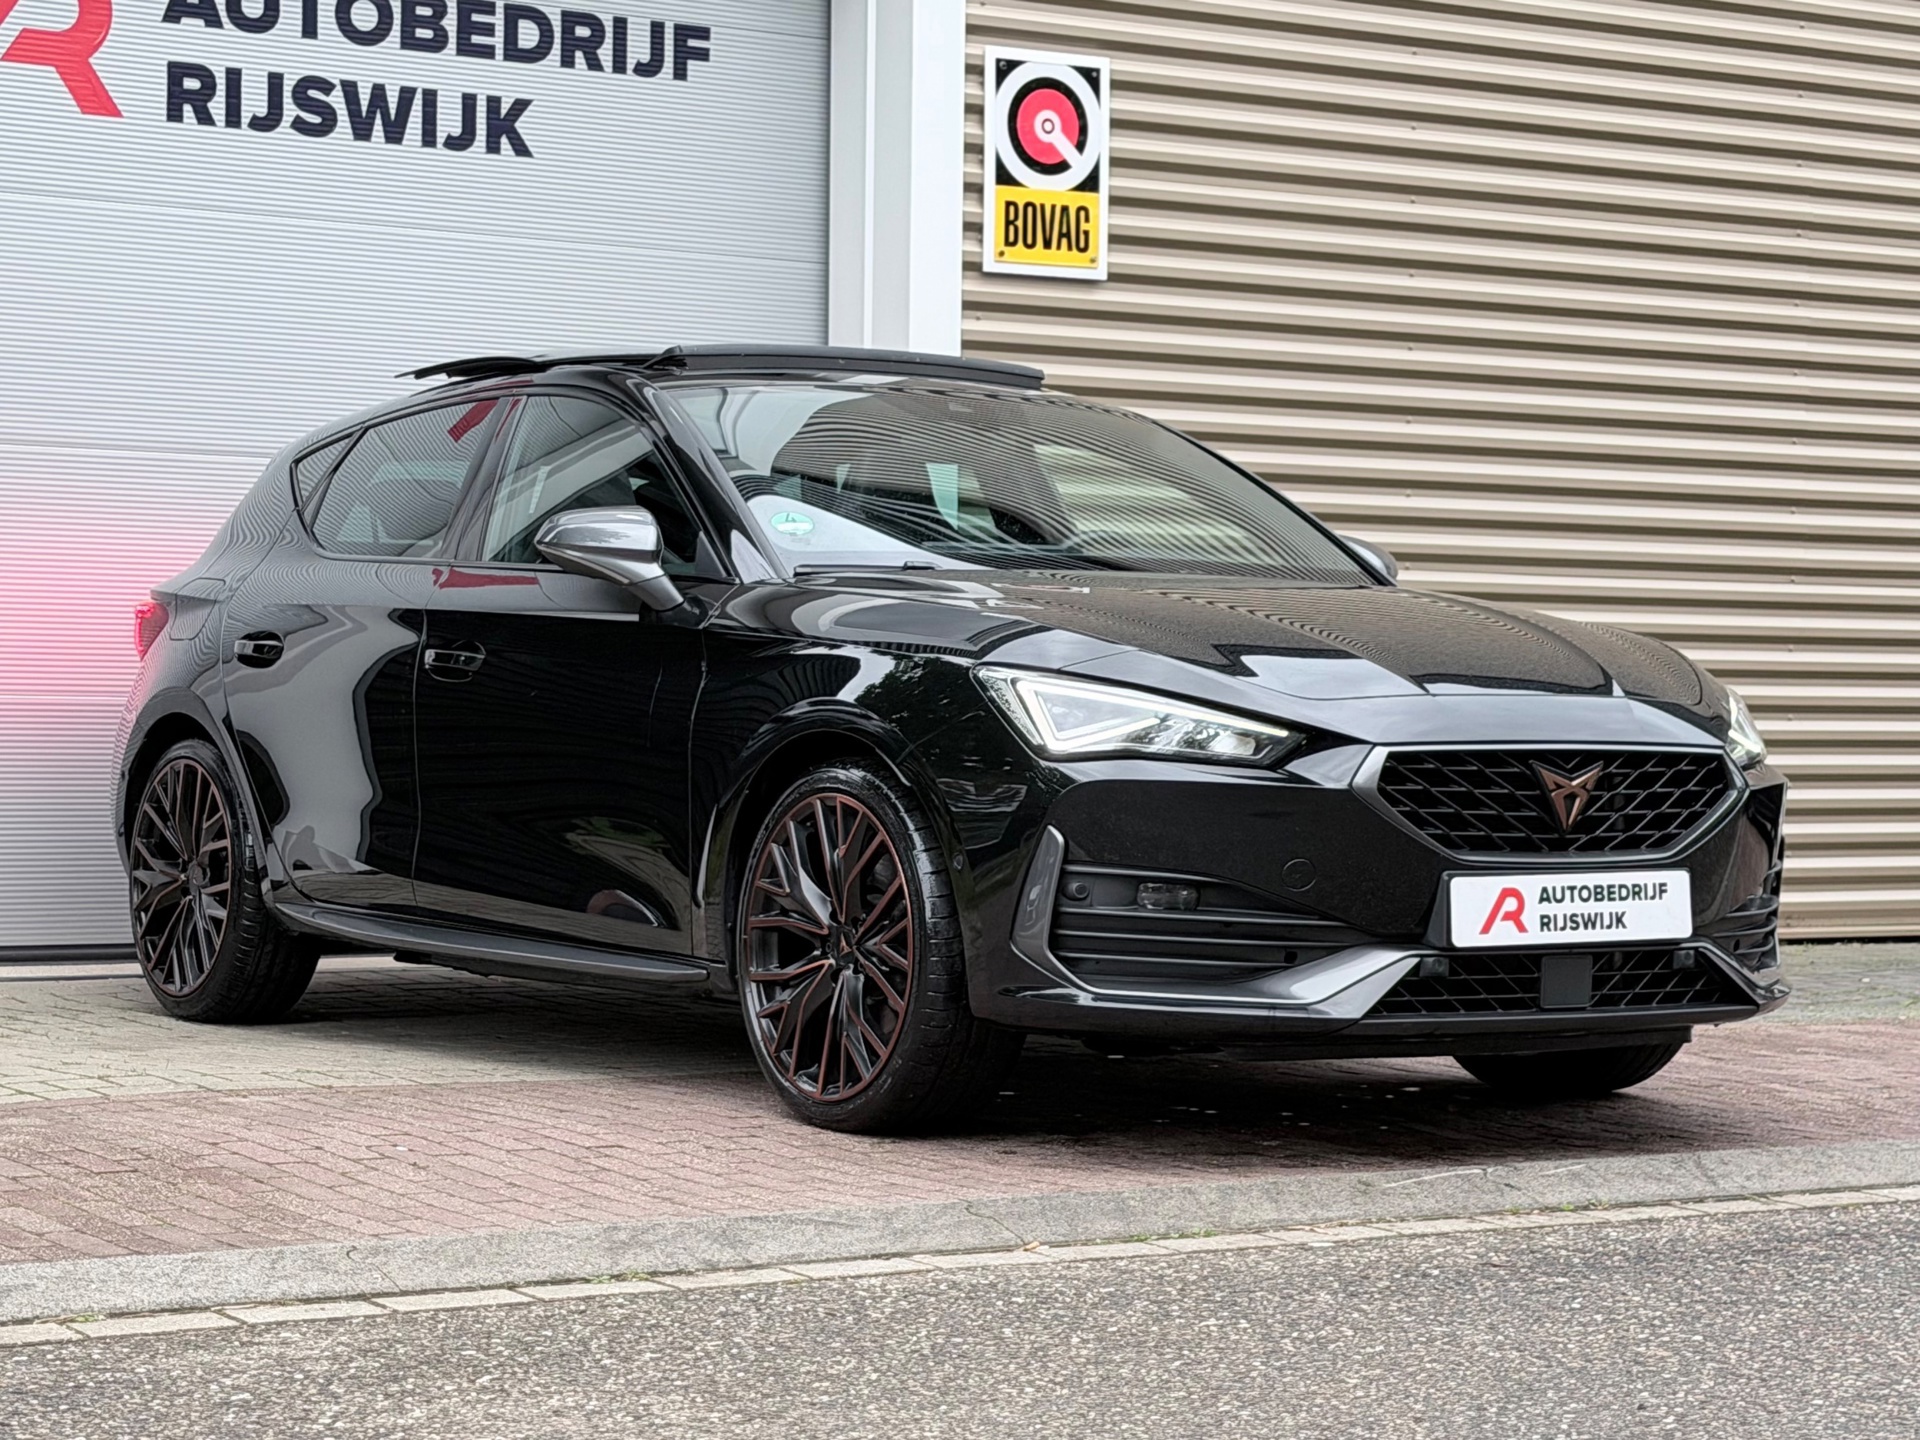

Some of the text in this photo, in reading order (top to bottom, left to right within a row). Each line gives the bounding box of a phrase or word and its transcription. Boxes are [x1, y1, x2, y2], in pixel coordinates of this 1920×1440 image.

[166, 60, 534, 158] RIJSWIJK
[1003, 200, 1090, 253] BOVAG
[1538, 882, 1668, 904] AUTOBEDRIJF
[1539, 911, 1628, 932] RIJSWIJK
